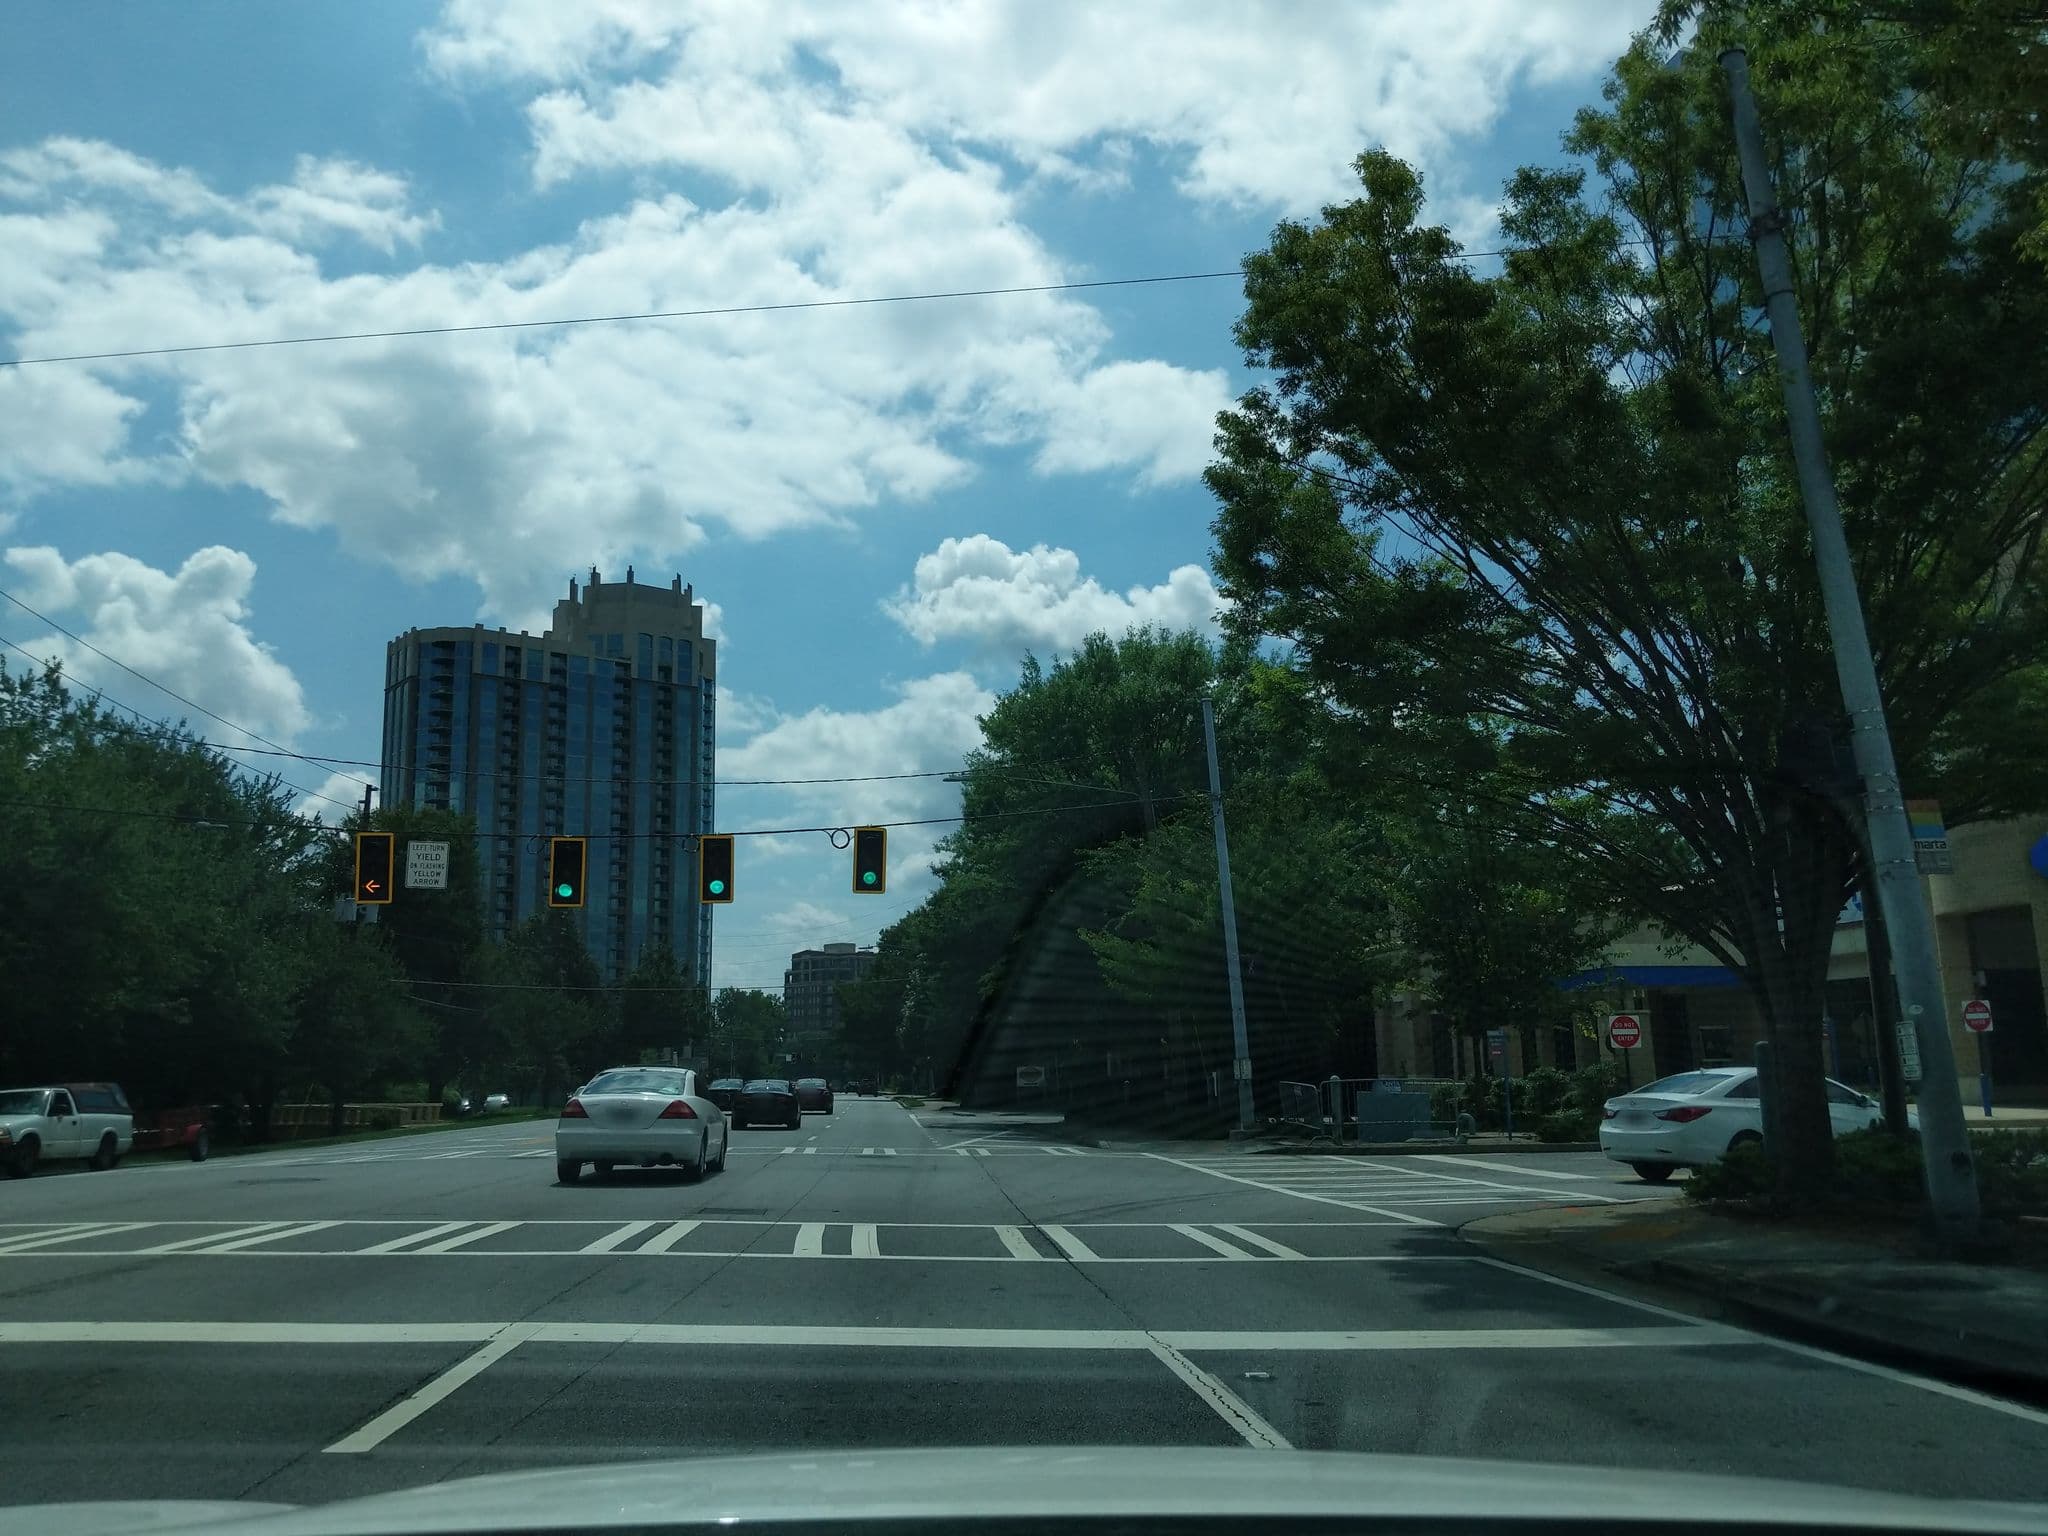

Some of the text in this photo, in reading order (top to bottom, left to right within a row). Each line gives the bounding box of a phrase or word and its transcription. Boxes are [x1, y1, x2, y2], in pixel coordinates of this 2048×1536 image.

[1914, 840, 1947, 849] marta
[416, 853, 441, 861] YIELD
[413, 870, 442, 878] YELLOW
[413, 878, 440, 886] ARROW
